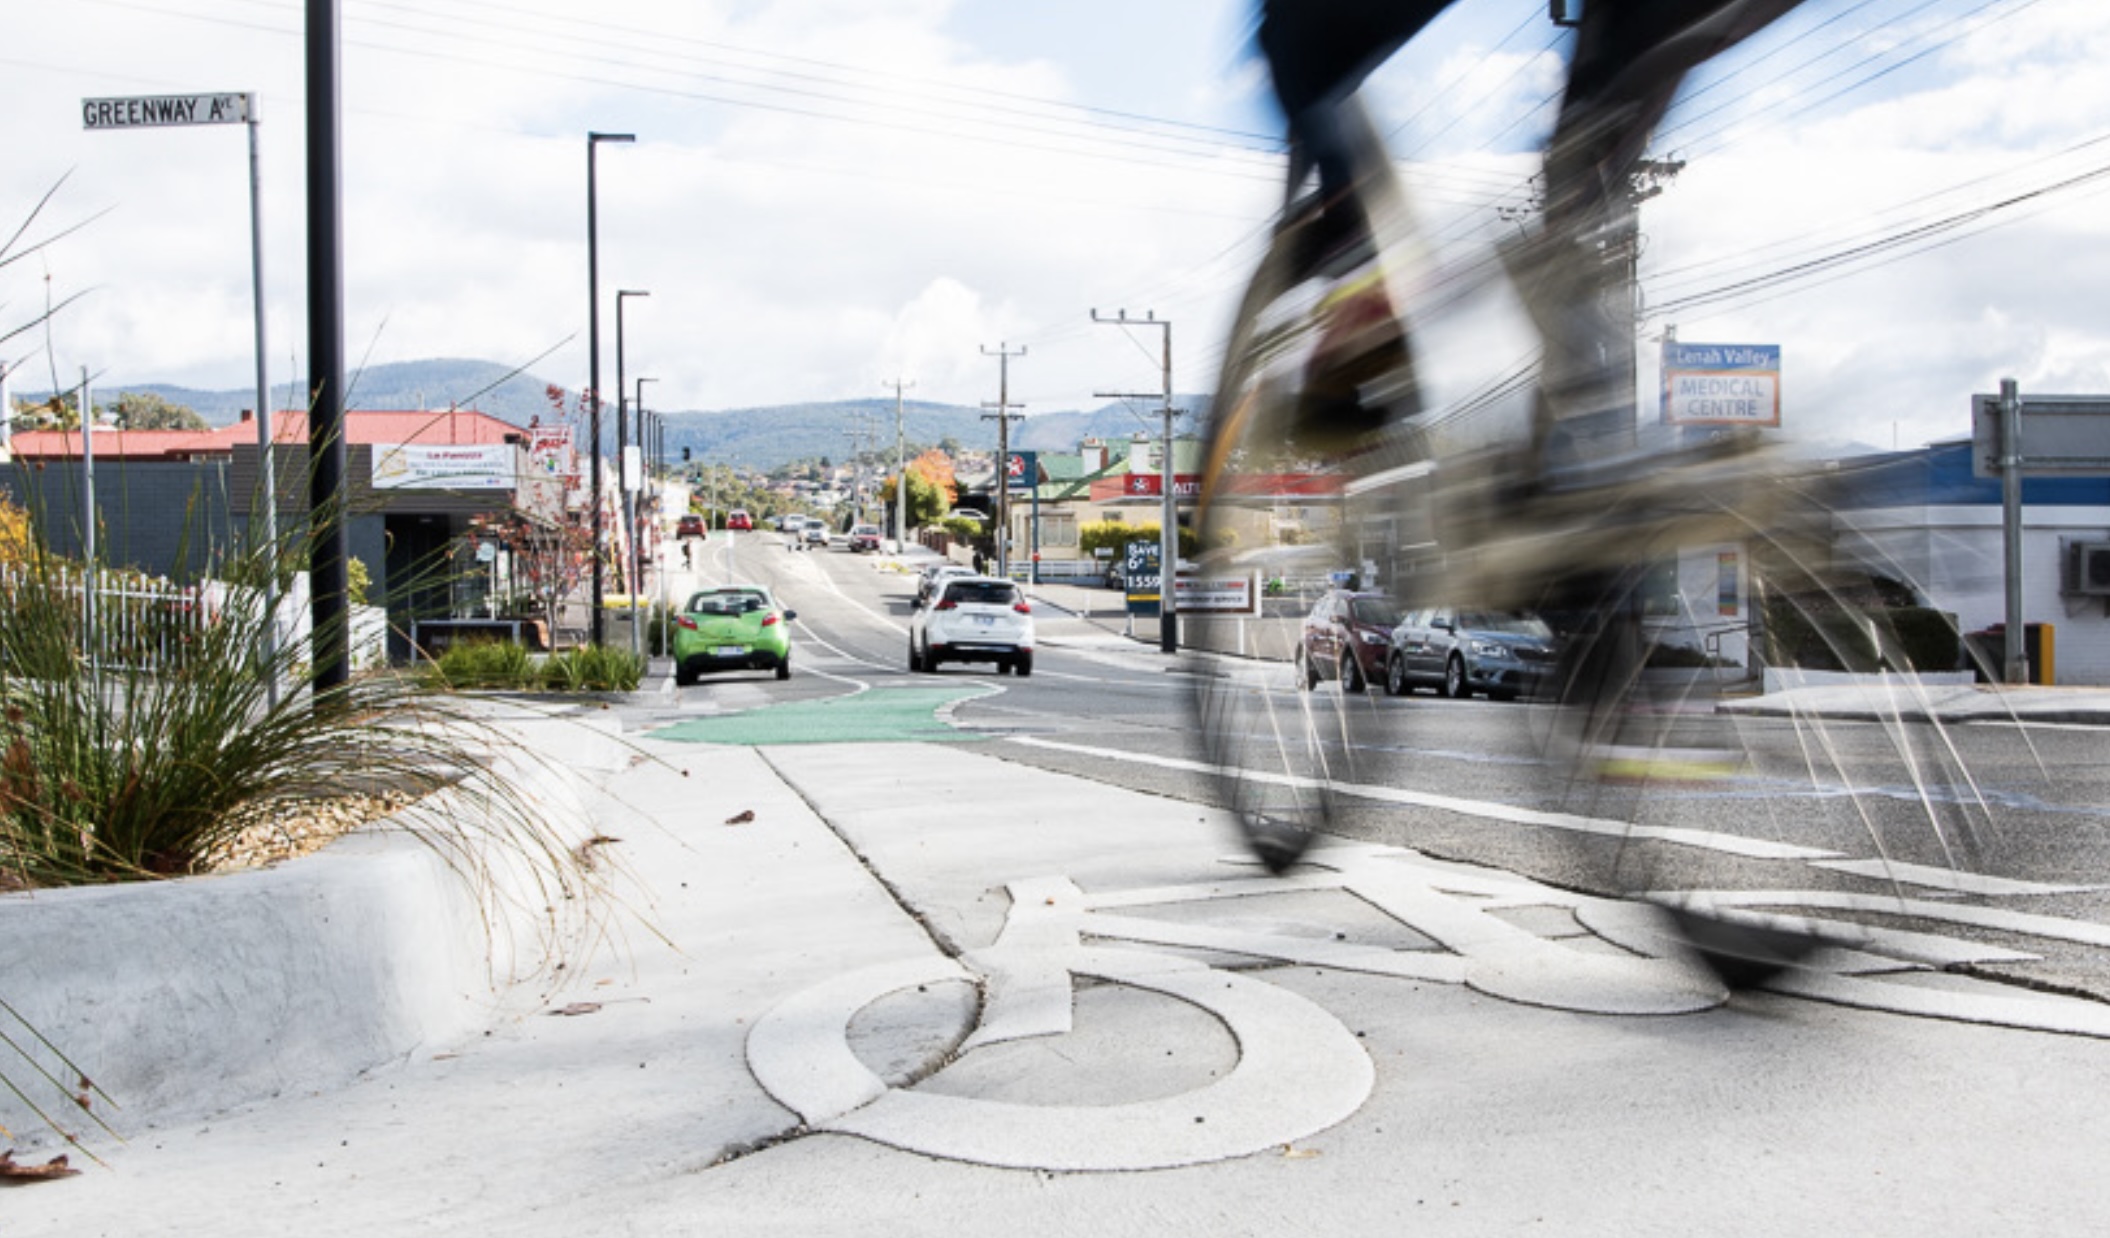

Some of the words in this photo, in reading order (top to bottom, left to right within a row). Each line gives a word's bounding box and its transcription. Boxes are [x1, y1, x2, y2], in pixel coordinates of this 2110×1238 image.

[82, 100, 198, 126] GREENWAY
[1677, 348, 1722, 364] Lenah
[1724, 348, 1770, 367] Valley
[1680, 378, 1764, 397] MEDICAL
[1687, 399, 1757, 416] CENTRE
